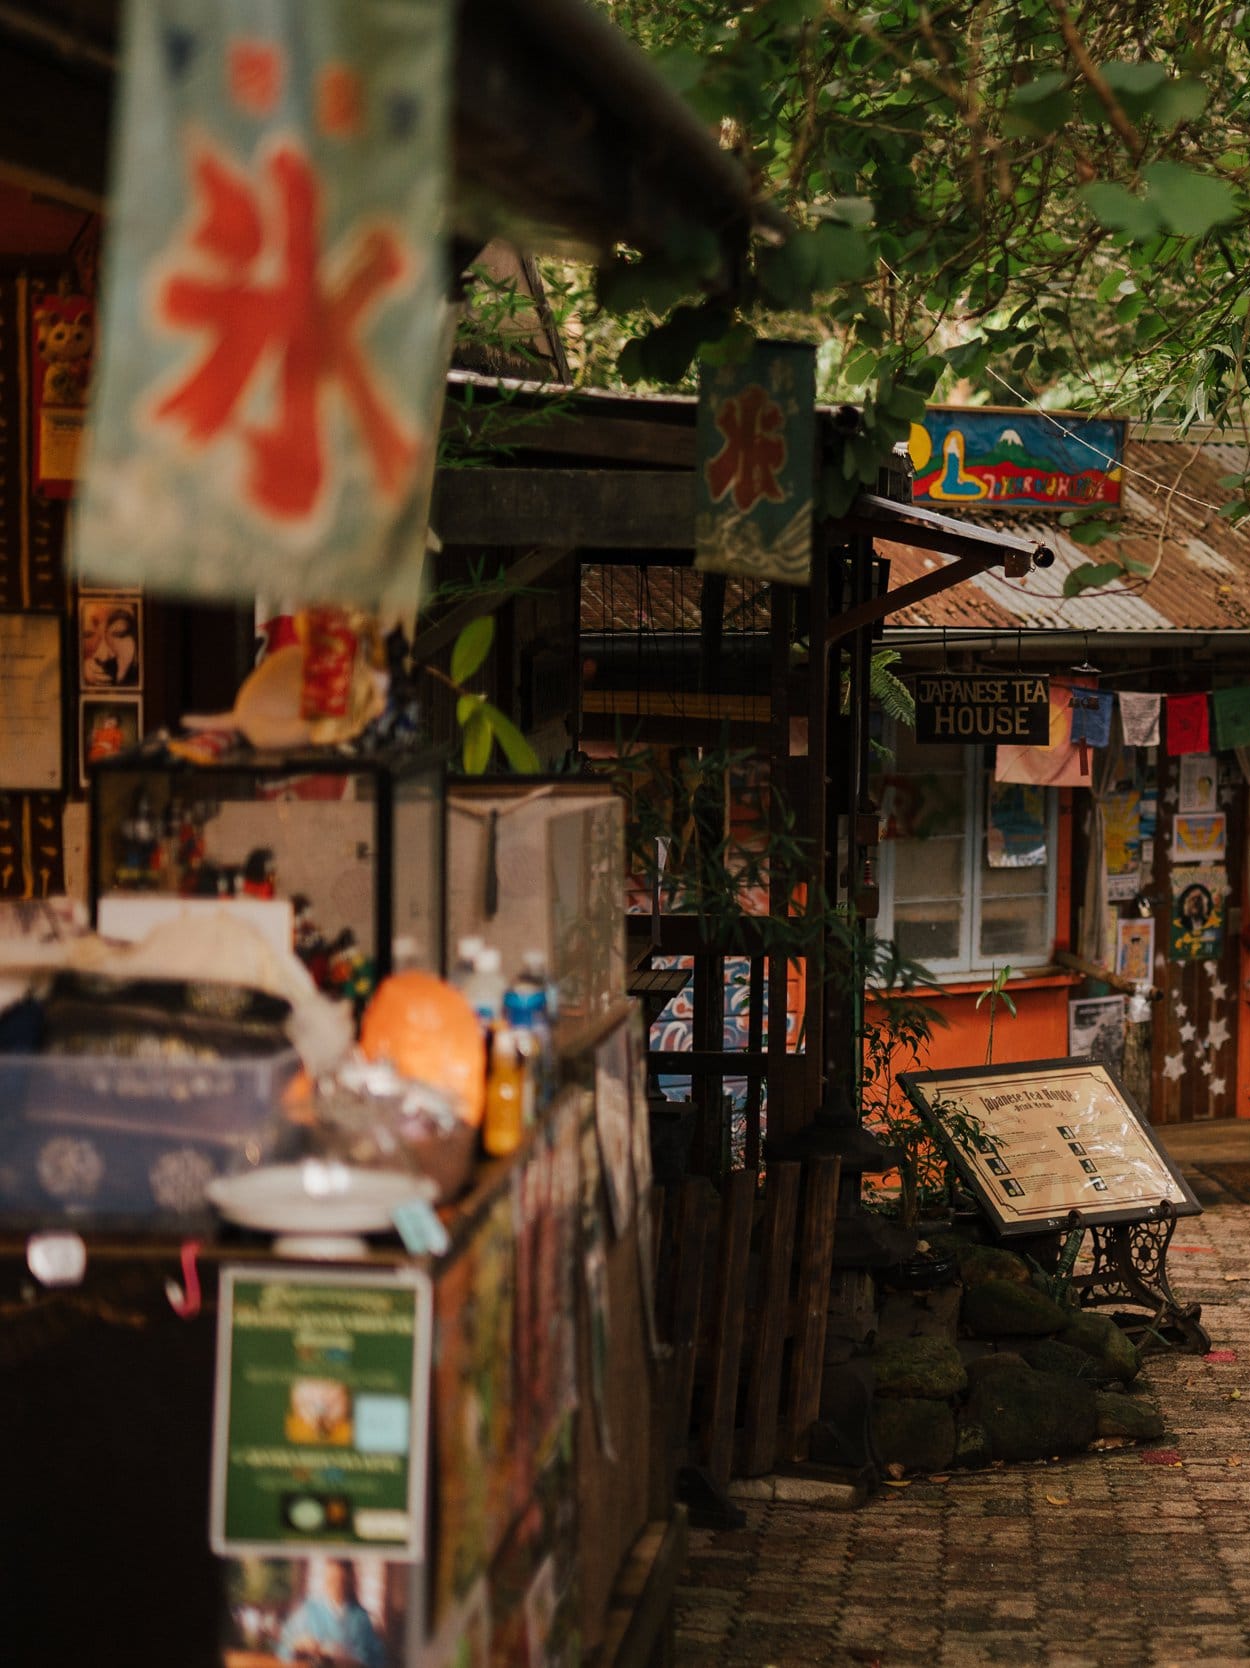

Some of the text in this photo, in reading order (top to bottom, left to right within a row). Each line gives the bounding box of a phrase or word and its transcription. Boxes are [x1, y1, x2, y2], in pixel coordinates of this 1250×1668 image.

[150, 138, 418, 522] 氷
[705, 384, 787, 514] 氷
[919, 680, 1048, 704] JAPANESE TEA
[934, 706, 1031, 735] HOUSE
[979, 1088, 1074, 1115] Japanese Tea House
